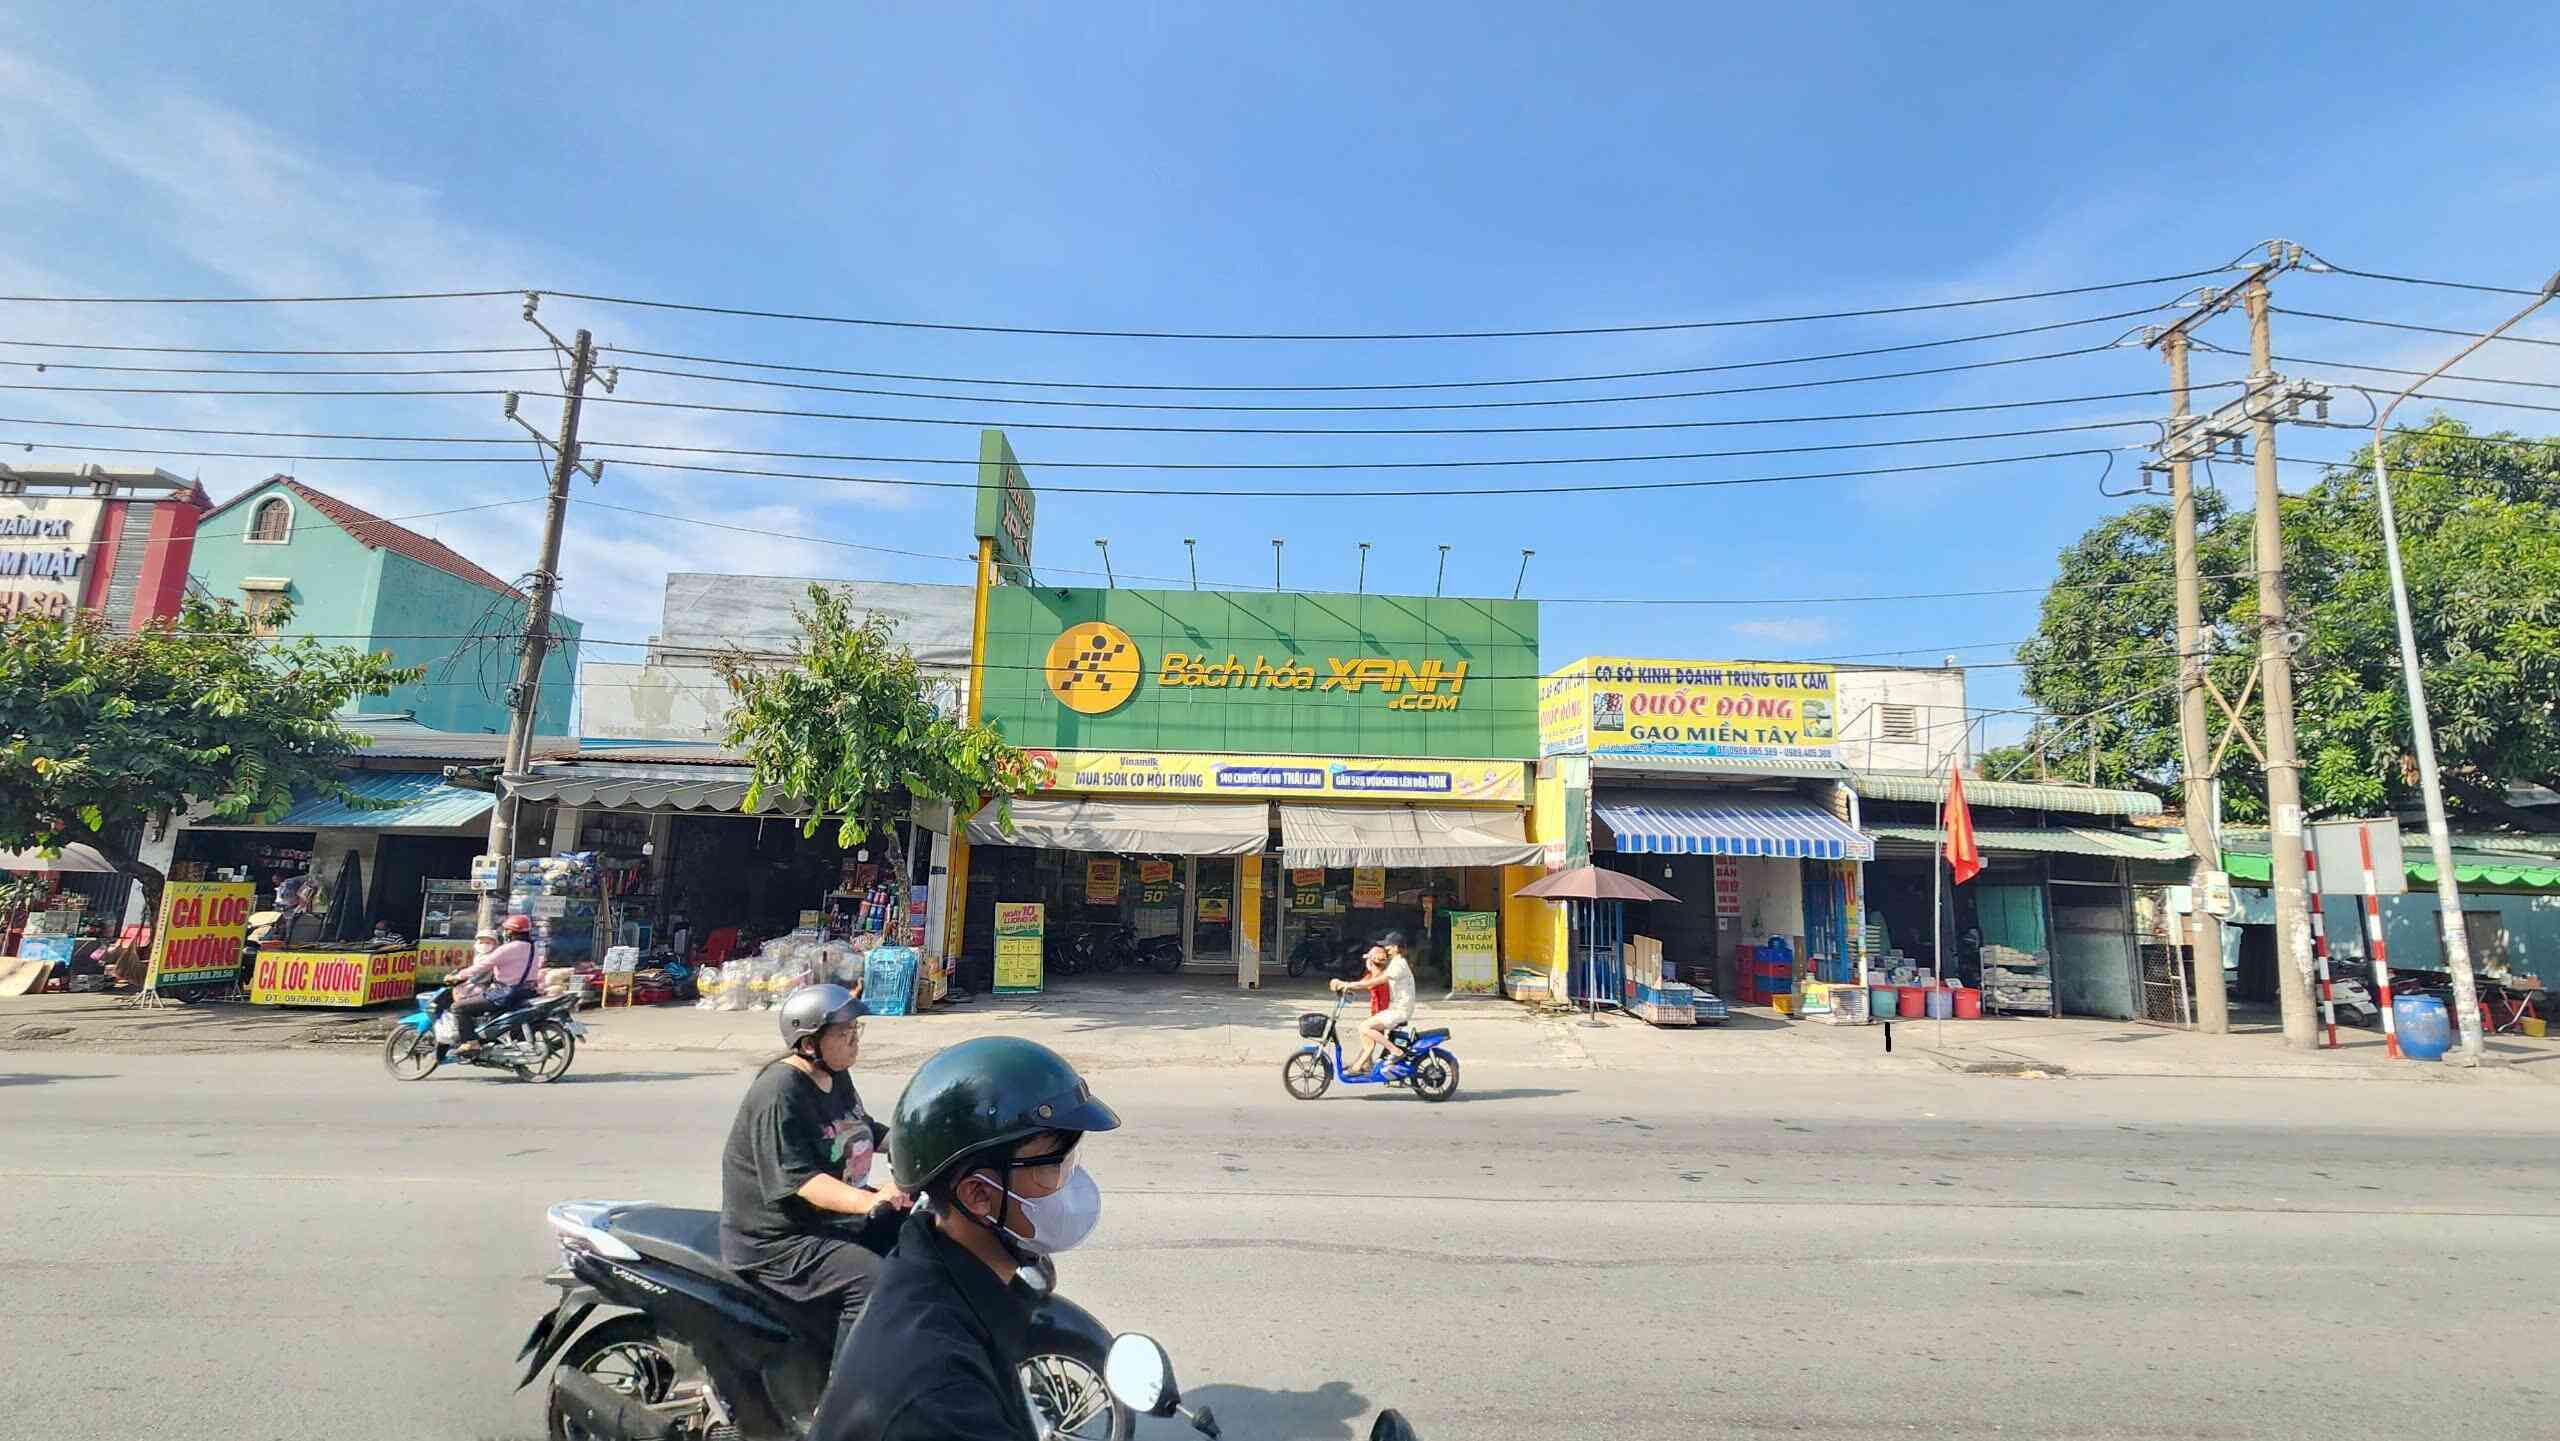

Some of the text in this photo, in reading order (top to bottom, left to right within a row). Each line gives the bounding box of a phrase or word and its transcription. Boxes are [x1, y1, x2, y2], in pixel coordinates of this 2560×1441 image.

[1158, 652, 1469, 694] Bách hóa XANH
[1638, 666, 1671, 684] KINH
[1676, 668, 1723, 686] DOANH
[1775, 673, 1797, 689] GIA
[1630, 688, 1793, 718] QUỐC ĐÔNG
[1630, 721, 1798, 744] GẠO MIỀN TÂY
[1120, 757, 1158, 767] Vinamilk
[1075, 772, 1100, 785] MUA
[172, 893, 250, 928] CÁ LÓC
[164, 933, 242, 969] NƯỚNG
[258, 956, 363, 992] CÁ LÓC NƯỚNG
